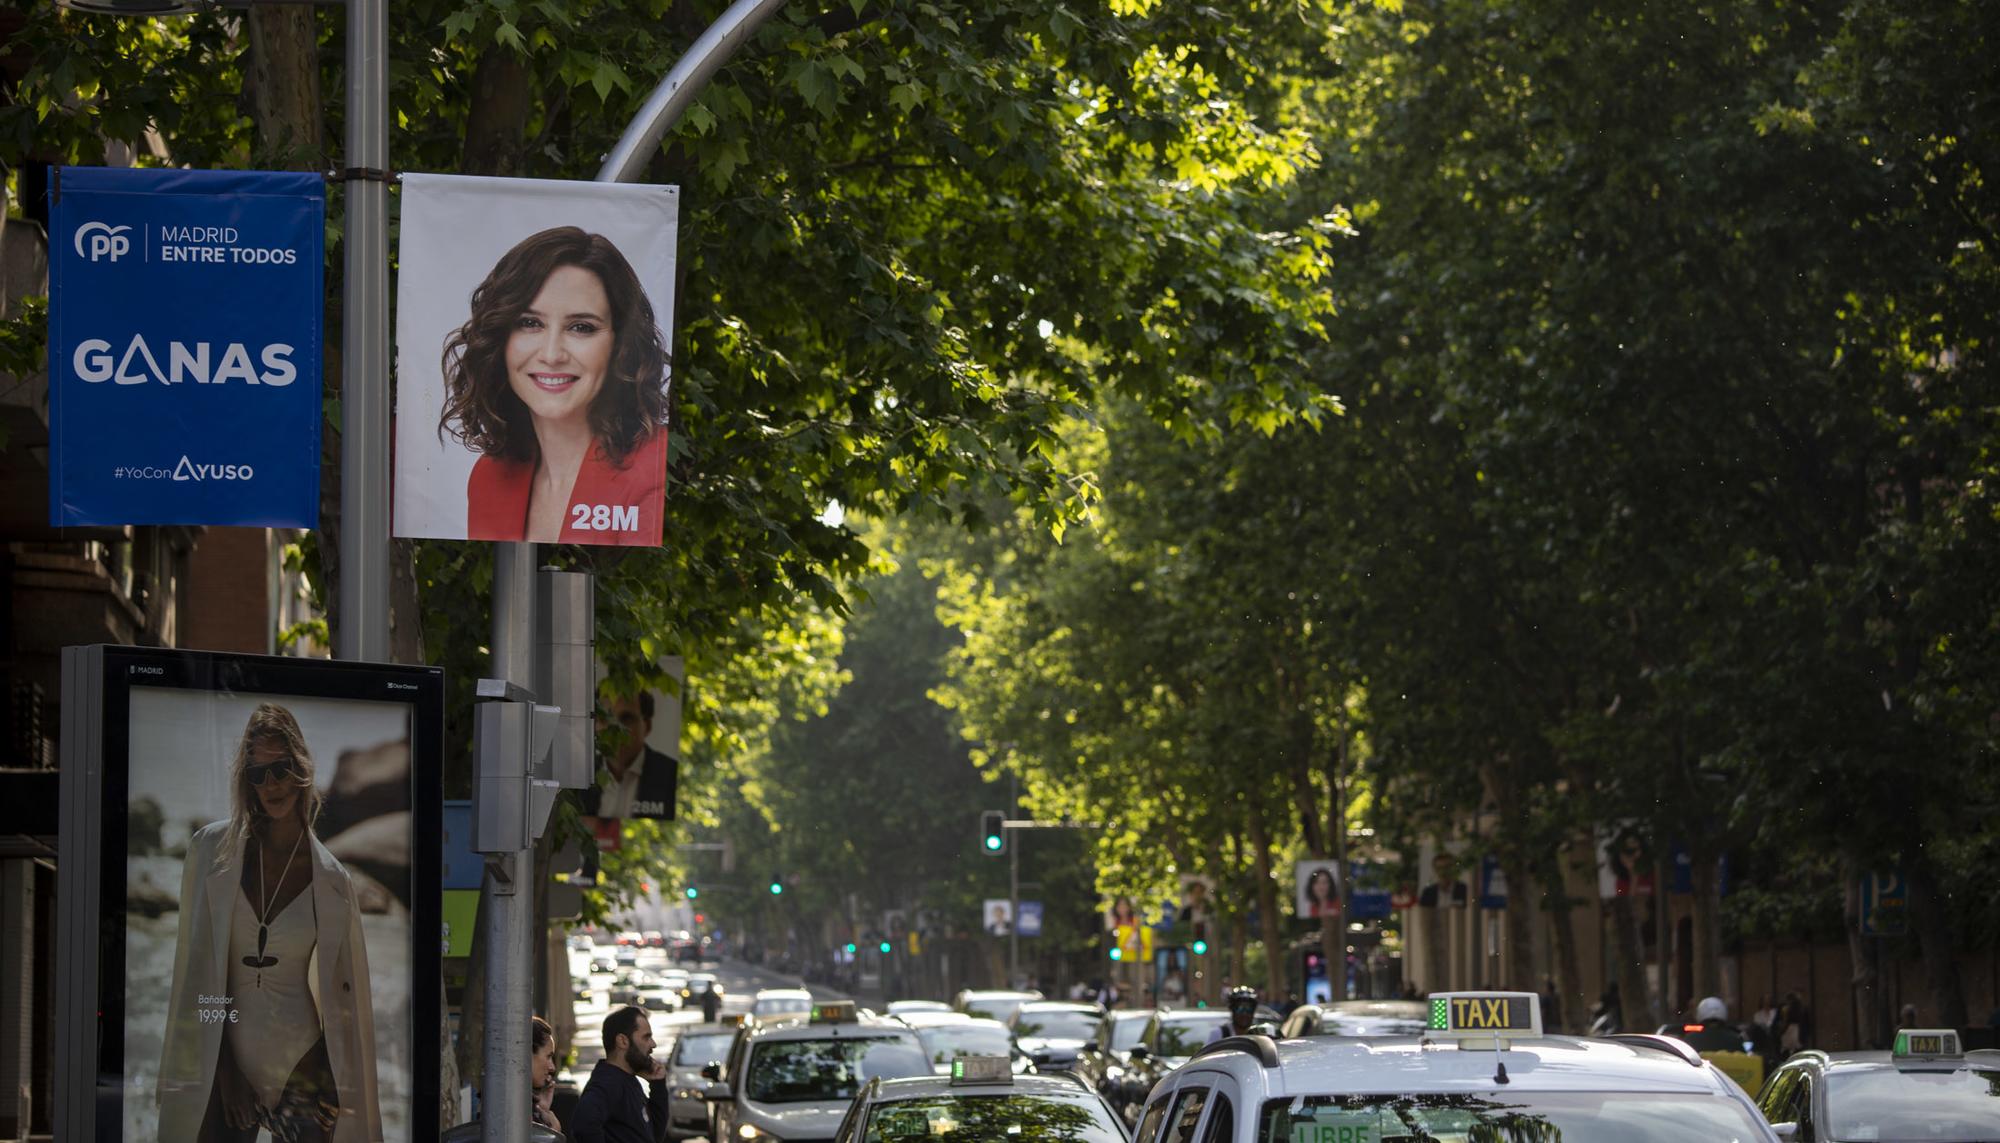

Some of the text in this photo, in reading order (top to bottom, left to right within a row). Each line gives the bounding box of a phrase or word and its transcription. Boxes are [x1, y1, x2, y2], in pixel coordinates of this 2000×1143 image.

[161, 226, 238, 244] MADRID
[161, 246, 297, 265] ENTRE TODOS
[73, 333, 297, 387] GANAS
[571, 503, 639, 532] 28M
[631, 801, 664, 815] 28M
[198, 994, 233, 1004] Bañador
[199, 1009, 239, 1024] 19,99 €
[1453, 999, 1510, 1027] TAXI
[1912, 1036, 1940, 1053] TAXI
[1299, 1126, 1369, 1143] LIBRE
